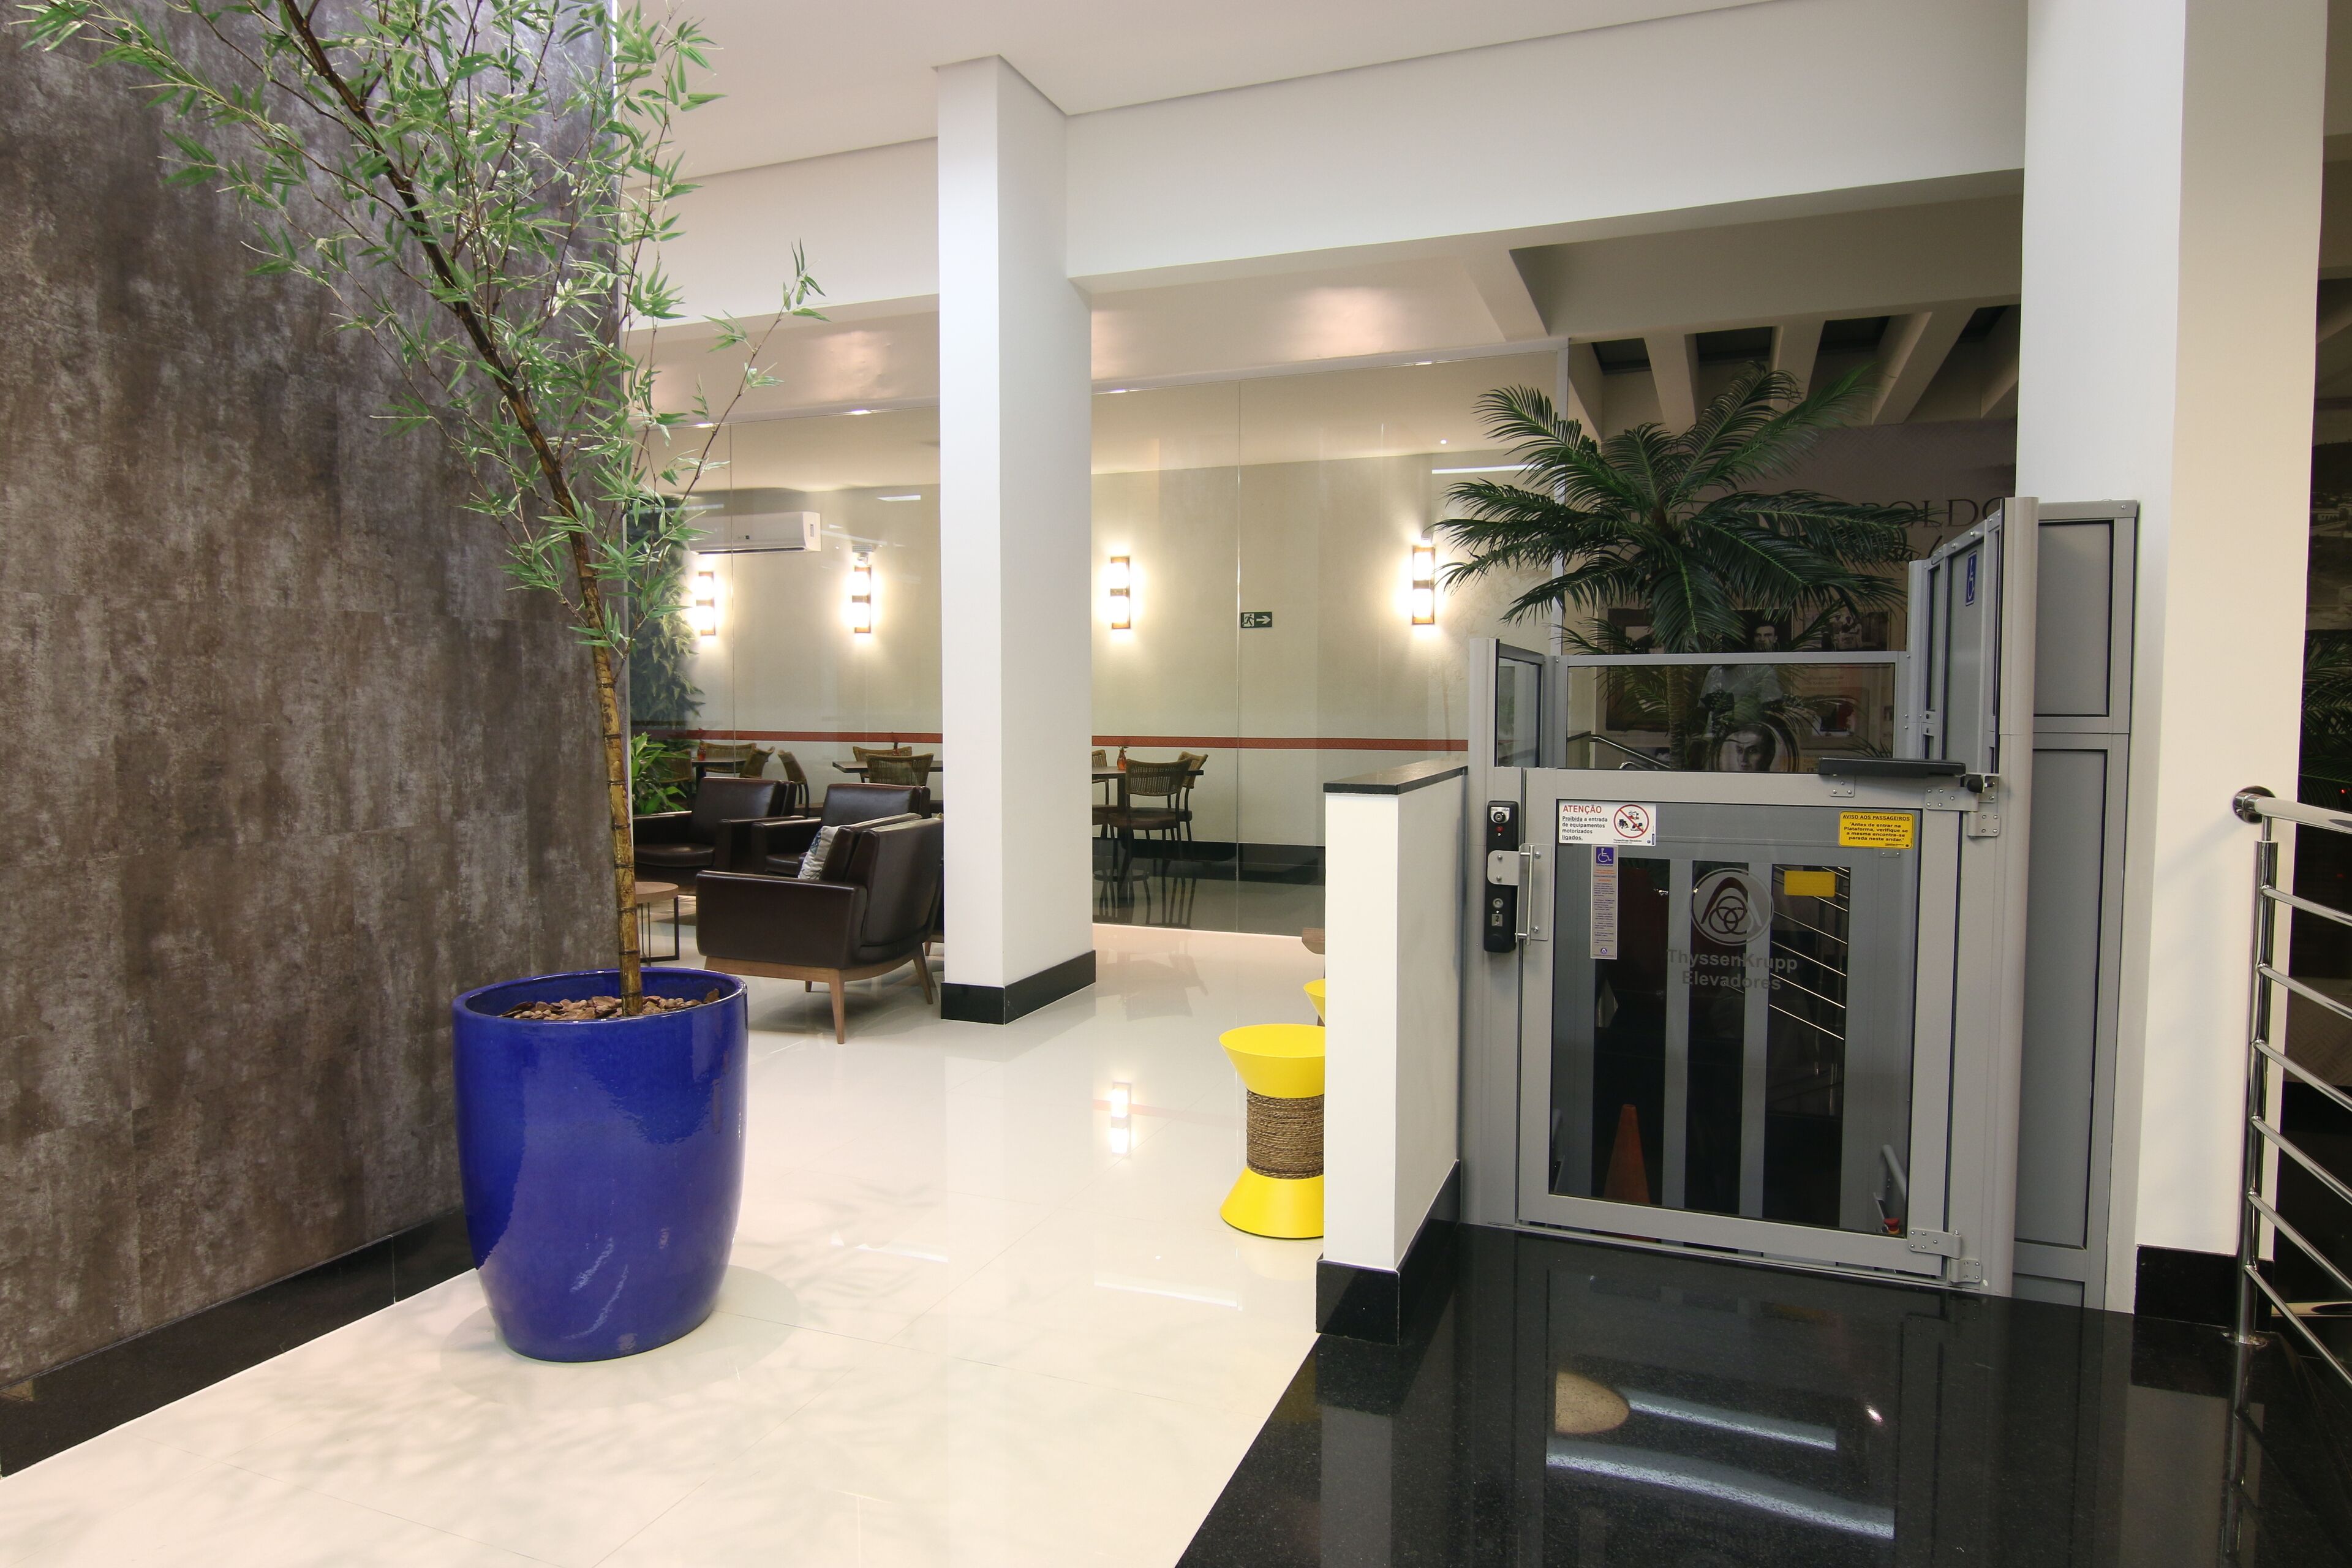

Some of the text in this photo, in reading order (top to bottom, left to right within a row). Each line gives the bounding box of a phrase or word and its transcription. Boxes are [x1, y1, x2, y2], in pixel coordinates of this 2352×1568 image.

[1563, 804, 1602, 815] ATENÇÃO
[1666, 949, 1798, 973] ThyssenKrupp
[1682, 970, 1781, 990] Elevadores
